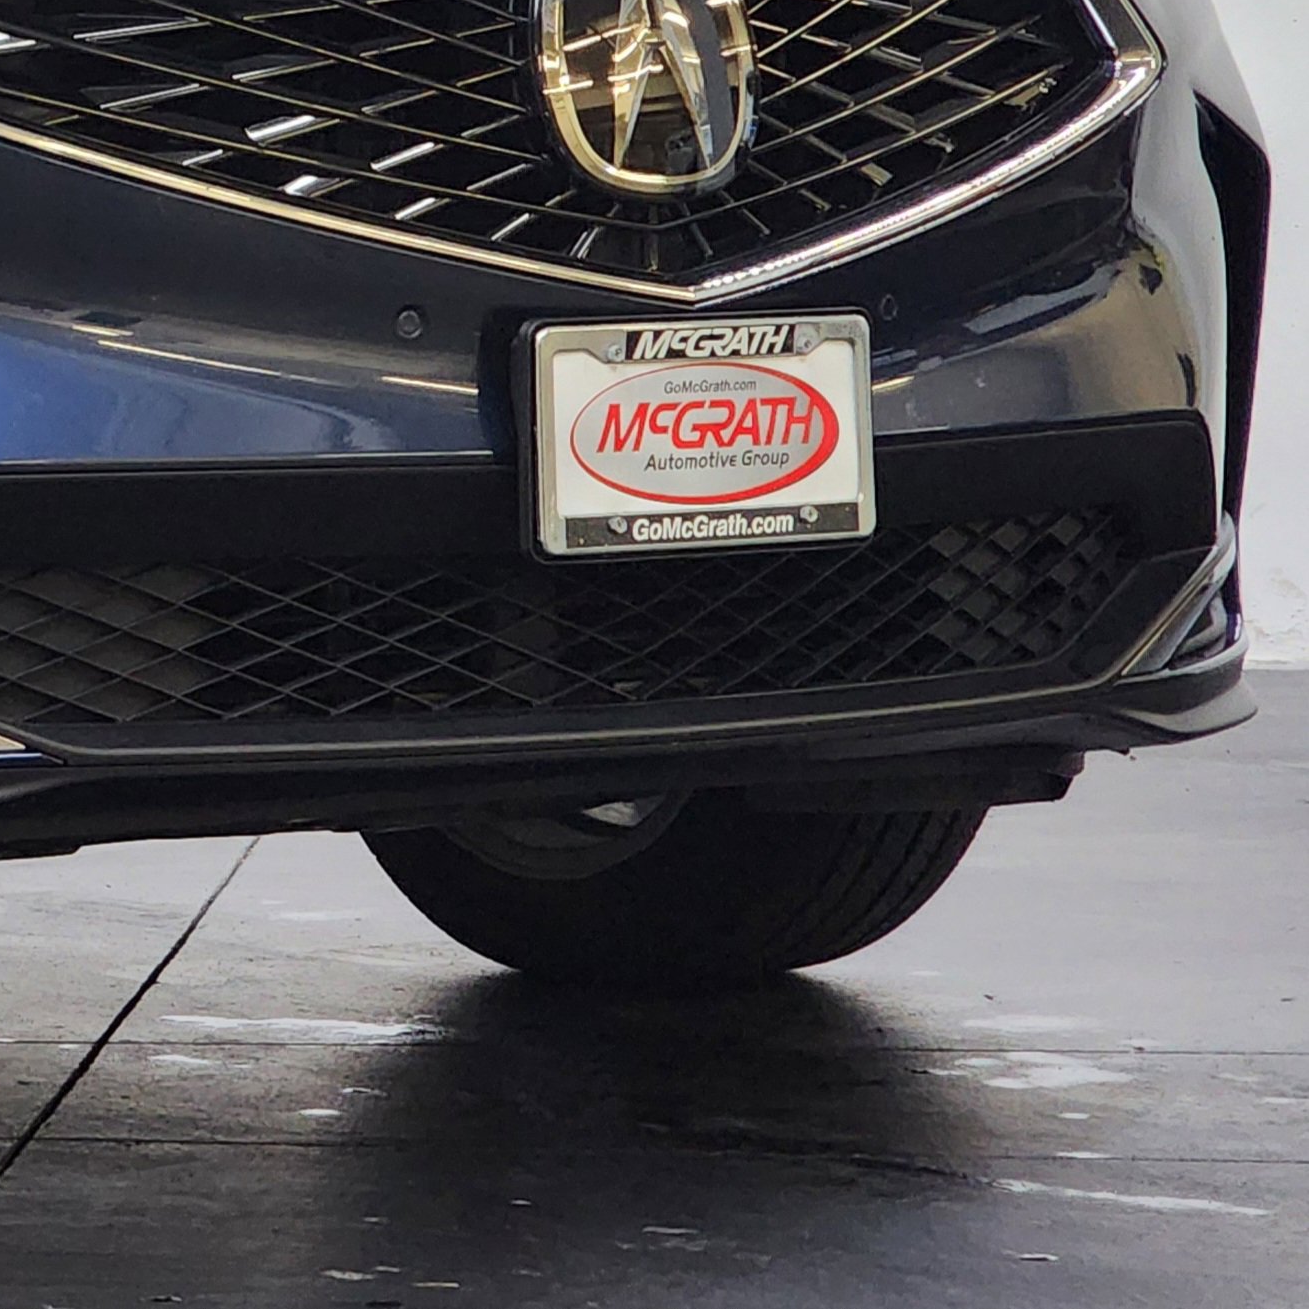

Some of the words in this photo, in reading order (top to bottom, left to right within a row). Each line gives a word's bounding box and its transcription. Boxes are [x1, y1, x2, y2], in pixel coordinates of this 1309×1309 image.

[664, 379, 757, 395] GoMcGrath.com
[644, 451, 737, 471] Automotive
[741, 450, 790, 469] Group
[633, 513, 794, 542] GoMcGrath.com
